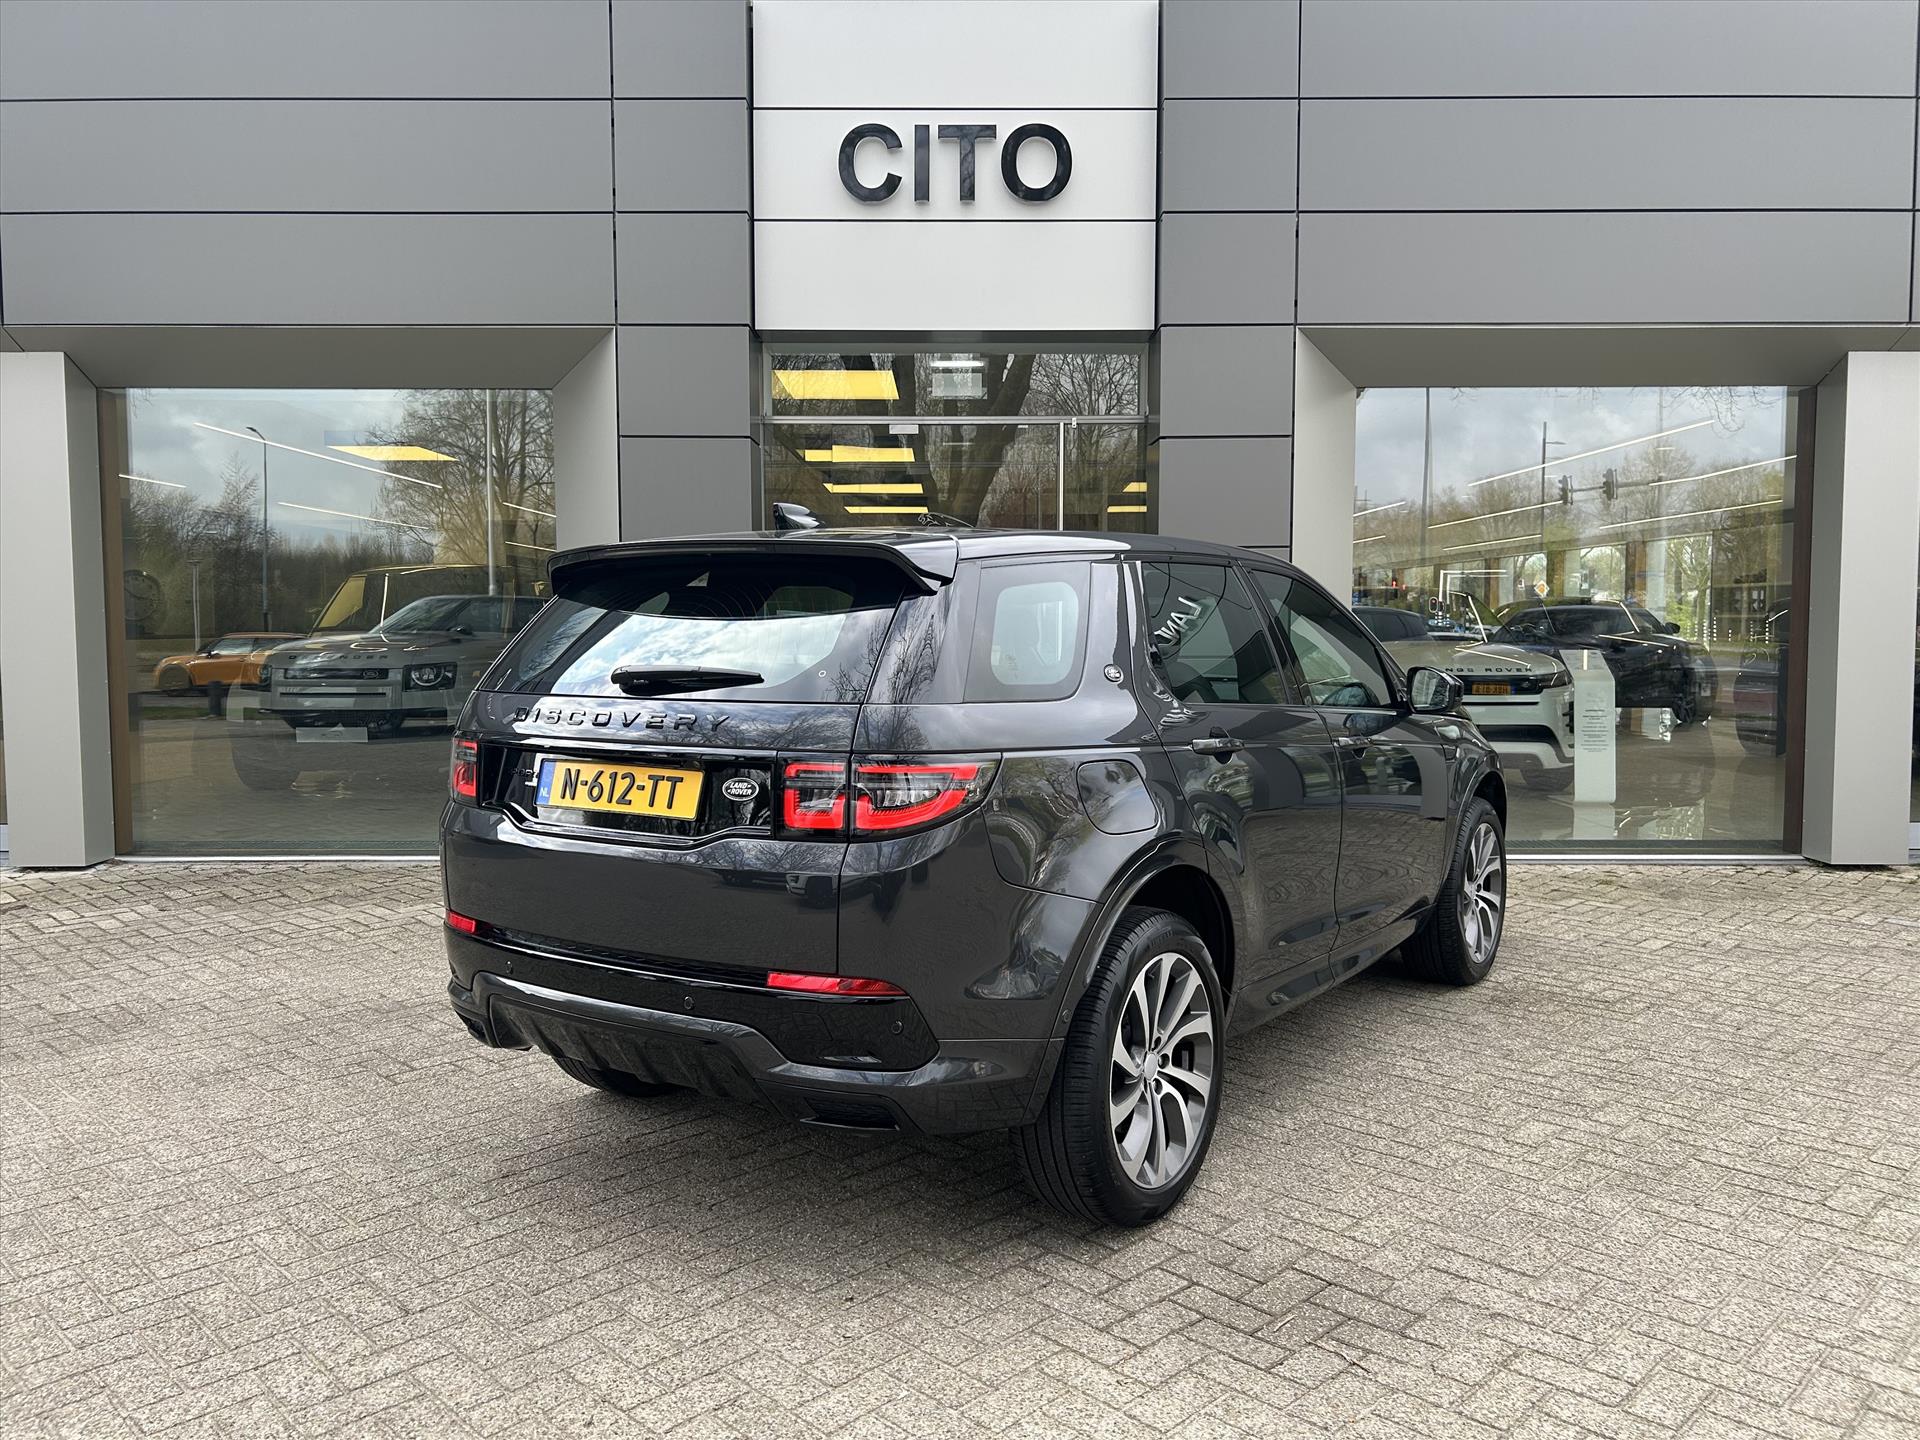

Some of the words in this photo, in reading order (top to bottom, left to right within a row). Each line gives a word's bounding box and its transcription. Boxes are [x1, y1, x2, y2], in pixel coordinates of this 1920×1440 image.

[838, 123, 1073, 203] CITO
[514, 707, 730, 732] DISCOVERY
[539, 787, 550, 797] NL
[560, 768, 685, 810] N-612-TT
[730, 788, 752, 796] ROVER
